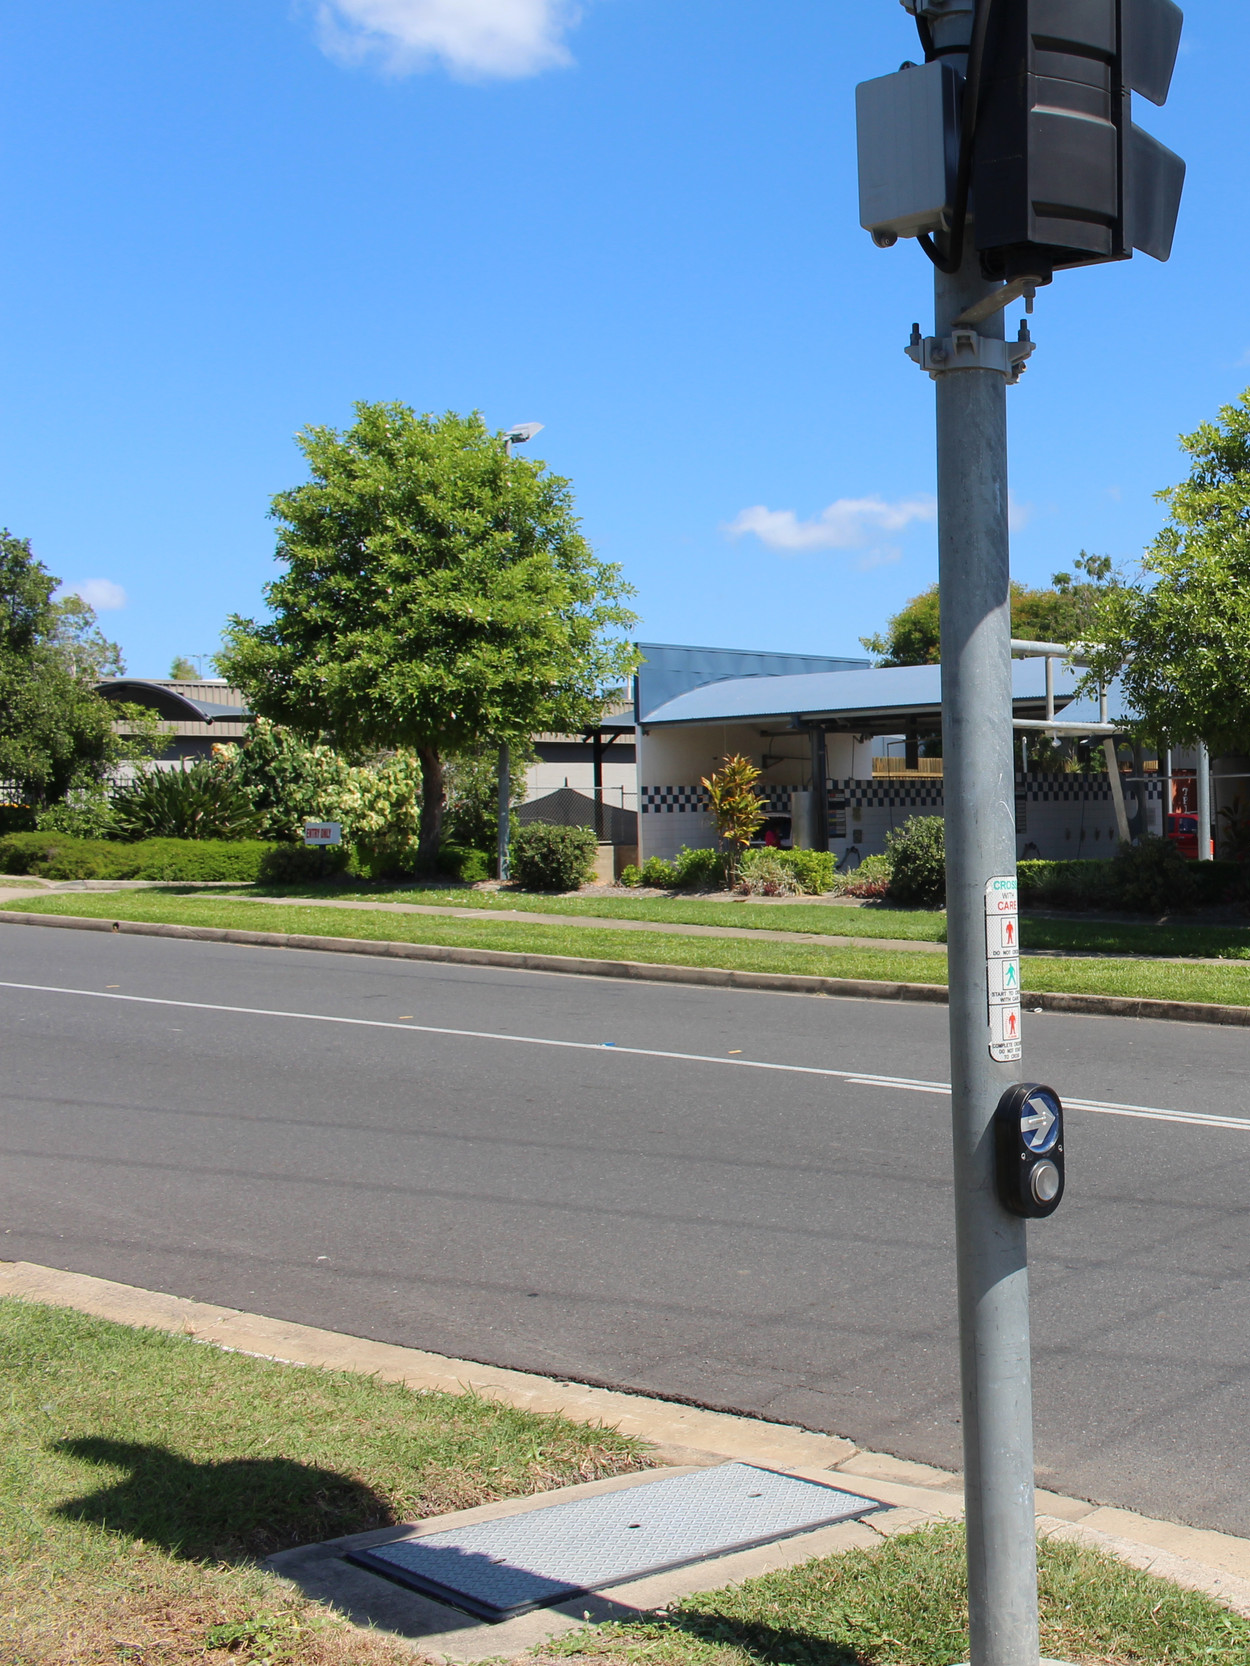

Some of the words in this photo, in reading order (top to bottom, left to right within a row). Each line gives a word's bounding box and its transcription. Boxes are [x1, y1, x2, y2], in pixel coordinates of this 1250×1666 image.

[306, 828, 320, 838] ENTRY
[321, 828, 331, 838] ONLY
[997, 900, 1017, 910] CARE
